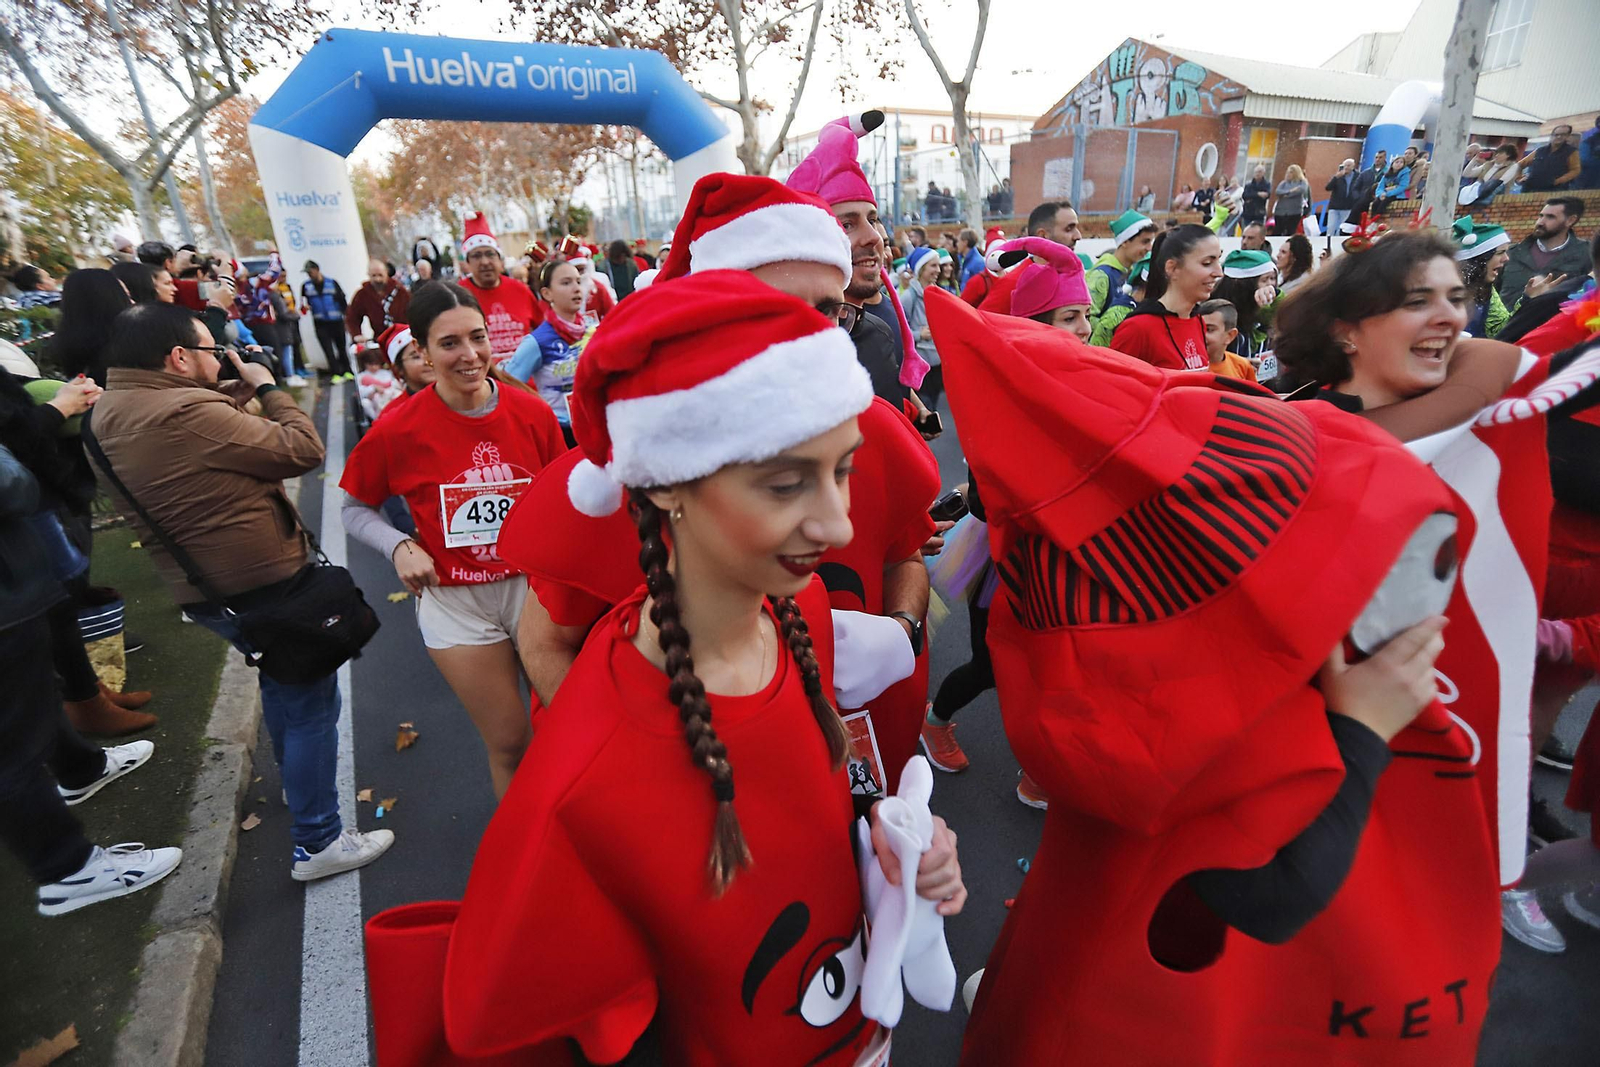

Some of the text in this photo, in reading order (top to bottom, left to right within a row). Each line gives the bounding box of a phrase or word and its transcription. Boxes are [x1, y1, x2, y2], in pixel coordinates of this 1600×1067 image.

[383, 47, 638, 99] Huelva original
[276, 190, 339, 207] Huelva
[467, 498, 510, 524] 438
[451, 567, 506, 582] Huelva
